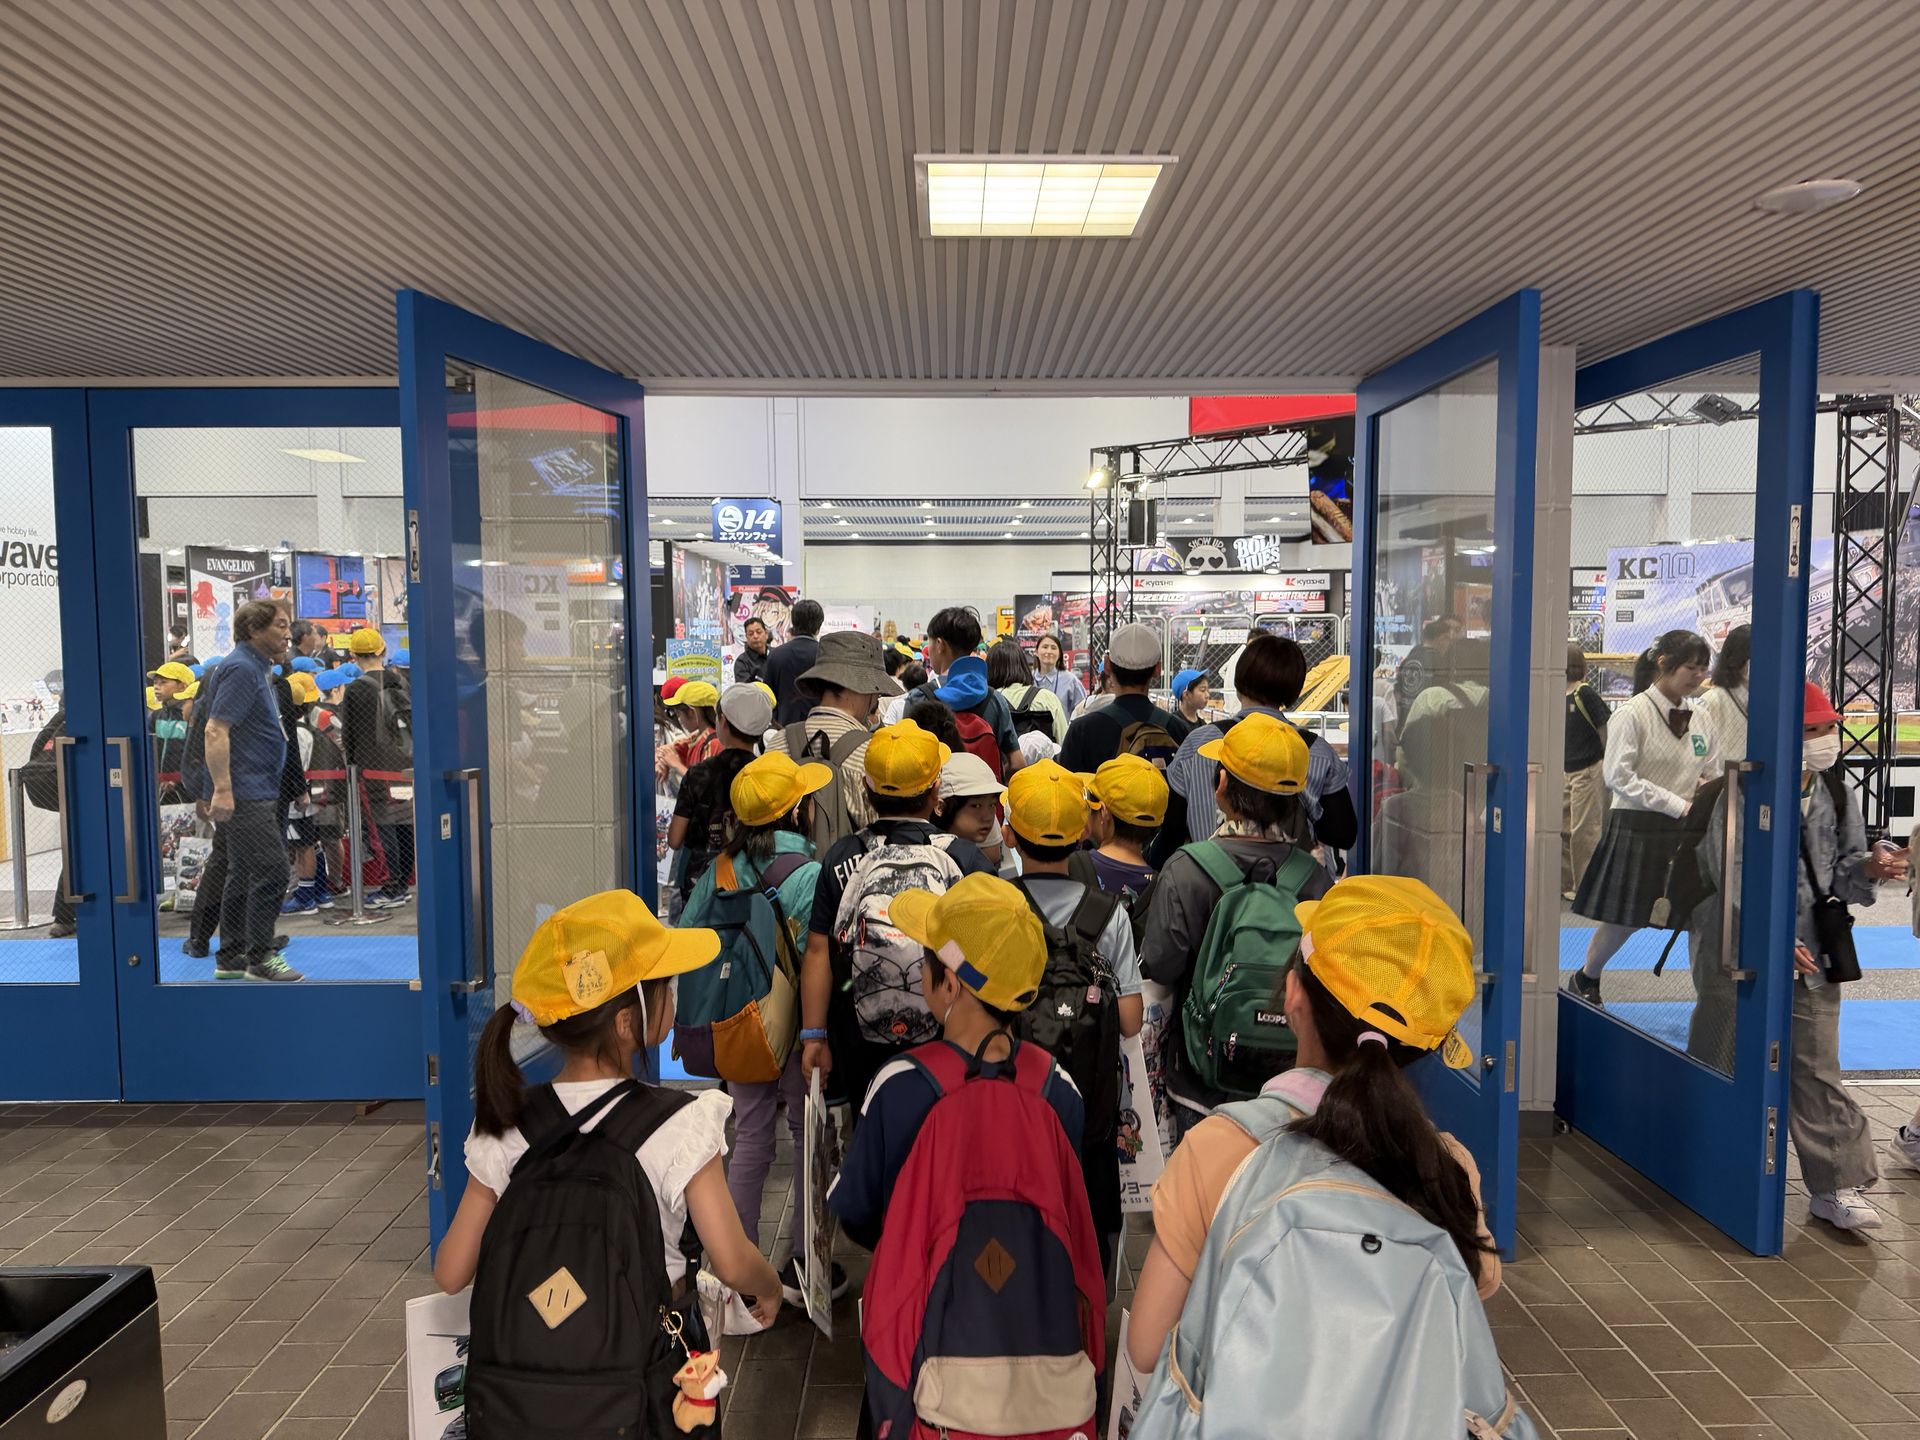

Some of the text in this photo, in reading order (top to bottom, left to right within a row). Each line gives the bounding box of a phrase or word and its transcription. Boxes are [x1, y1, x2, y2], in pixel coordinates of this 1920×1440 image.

[743, 509, 776, 530] 14
[719, 532, 776, 541] エスワンフォー
[206, 557, 256, 573] EVANGELION
[1240, 547, 1281, 572] HUES
[1616, 552, 1697, 580] KC10
[0, 570, 58, 589] rporatio
